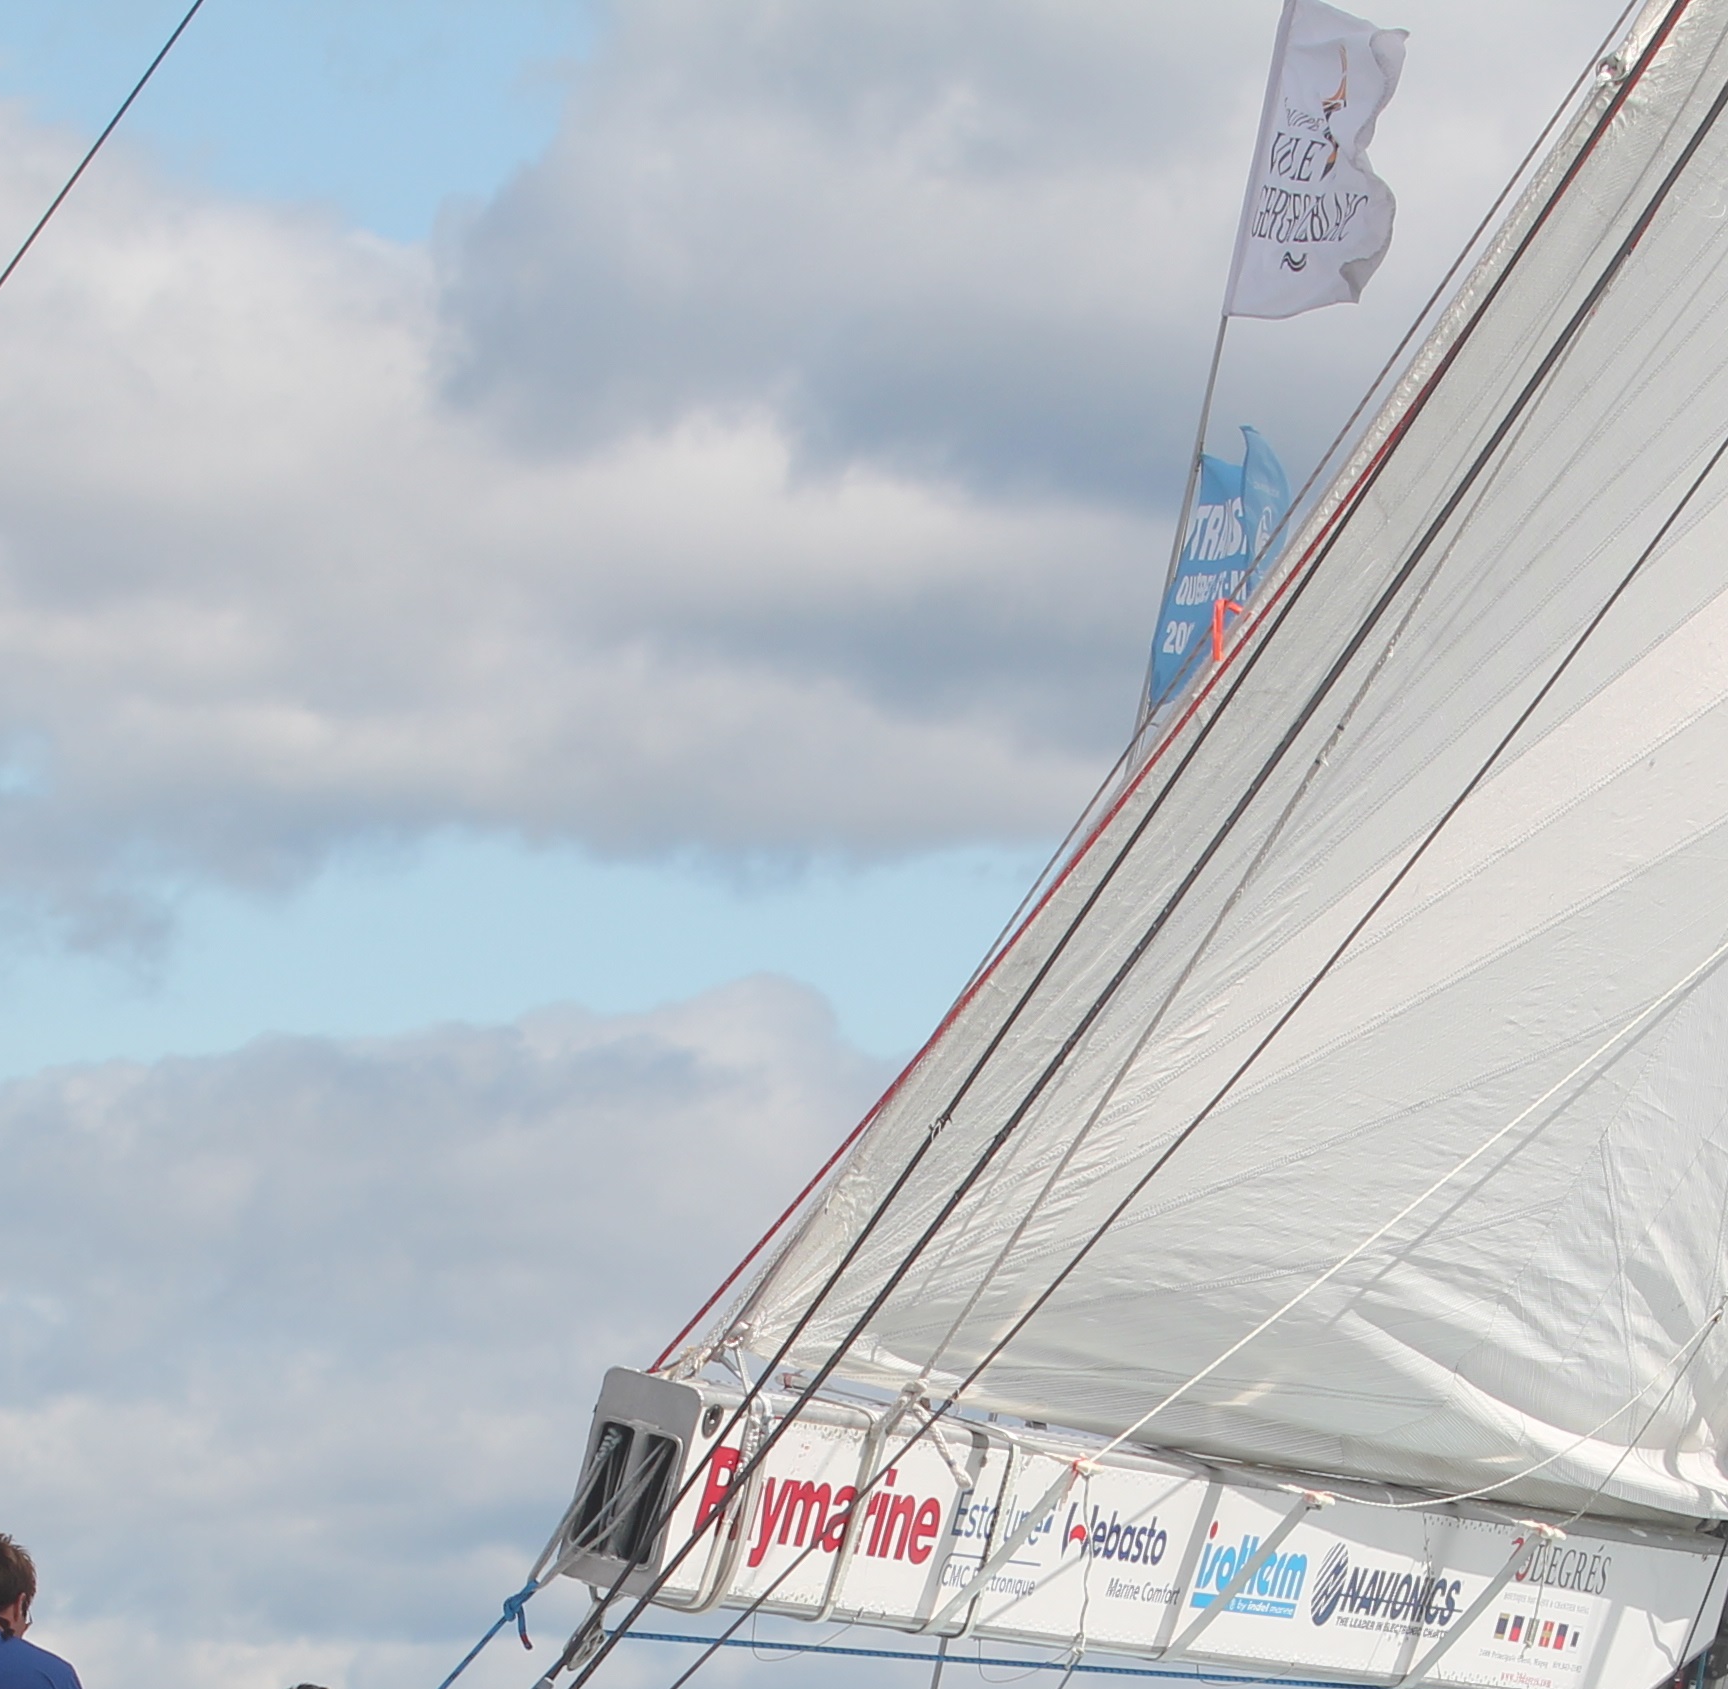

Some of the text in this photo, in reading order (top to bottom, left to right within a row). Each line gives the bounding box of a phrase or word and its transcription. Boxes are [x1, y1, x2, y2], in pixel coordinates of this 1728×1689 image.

[693, 1446, 941, 1568] Rymarine
[1061, 1501, 1167, 1566] Webasto
[1105, 1577, 1181, 1605] Marine Comfort
[1338, 1566, 1463, 1627] NAVIONICS
